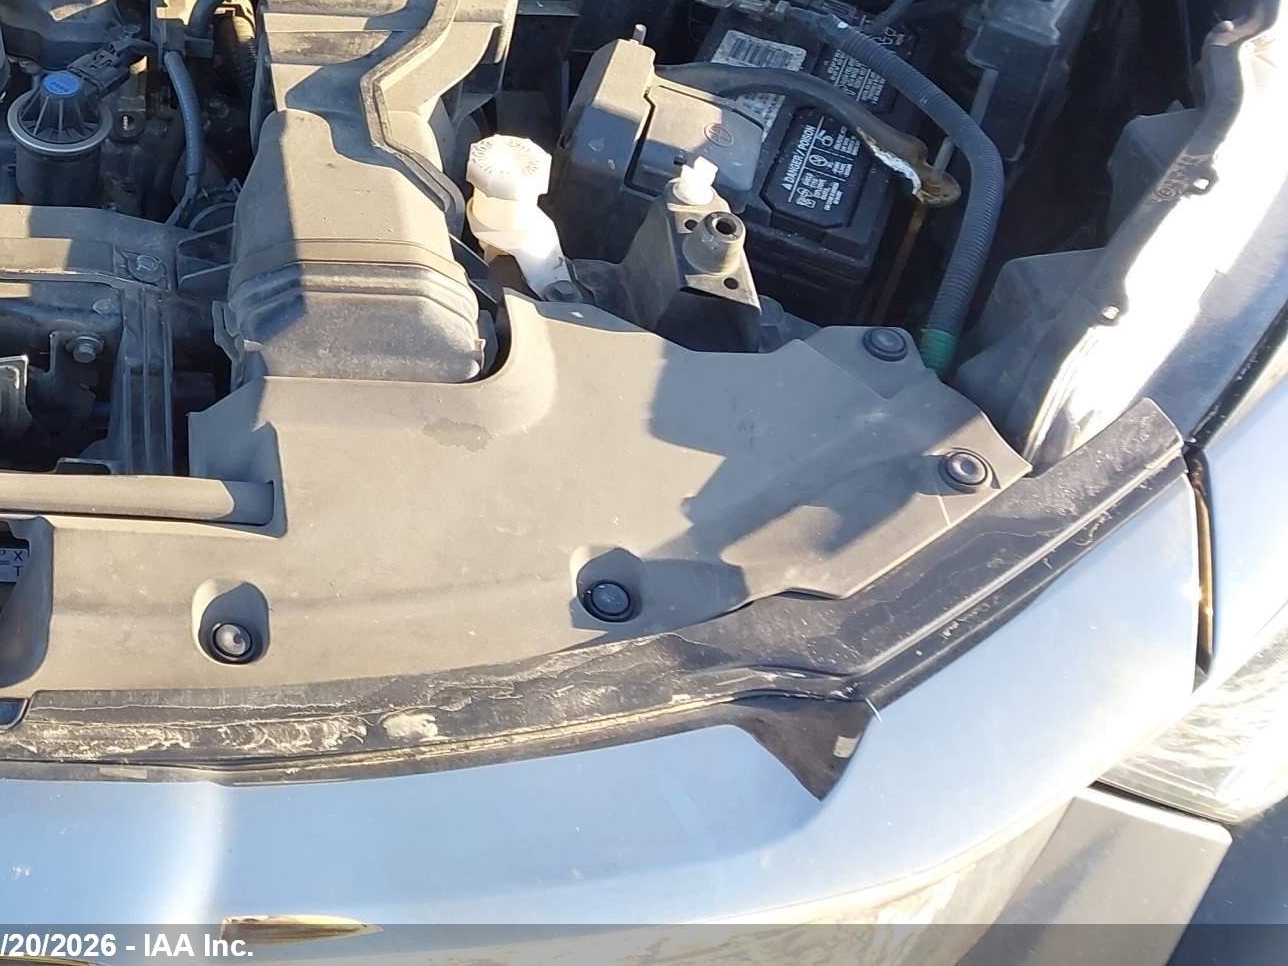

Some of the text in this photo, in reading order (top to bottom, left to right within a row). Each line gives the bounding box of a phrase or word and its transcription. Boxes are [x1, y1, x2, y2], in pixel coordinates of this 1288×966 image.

[783, 153, 804, 183] DANGER
[796, 123, 816, 151] POISON
[13, 550, 24, 562] X
[13, 565, 24, 577] T
